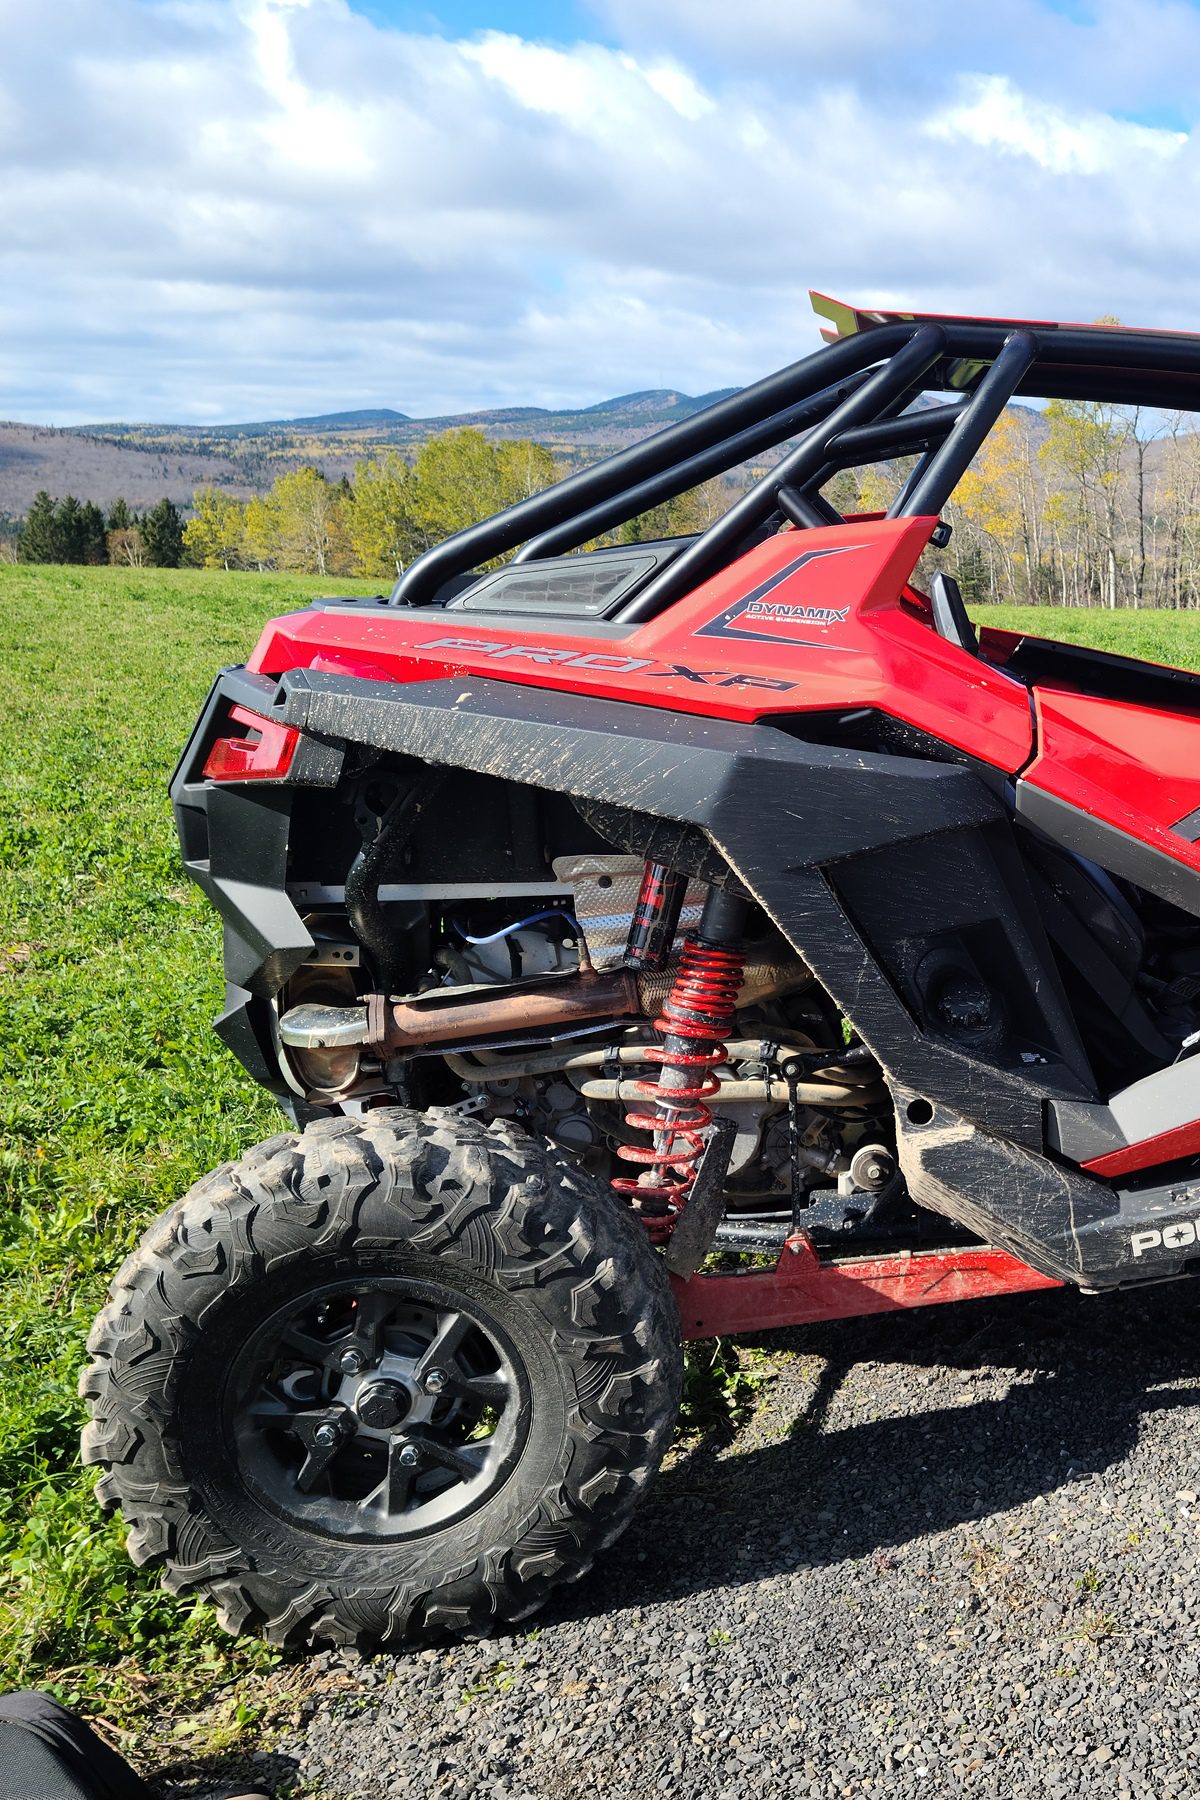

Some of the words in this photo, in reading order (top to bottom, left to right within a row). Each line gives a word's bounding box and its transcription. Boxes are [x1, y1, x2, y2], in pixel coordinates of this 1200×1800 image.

[746, 601, 850, 626] DYNAMIX
[775, 616, 827, 626] SUSPENSION
[412, 636, 659, 673] PRO
[639, 663, 801, 692] XP
